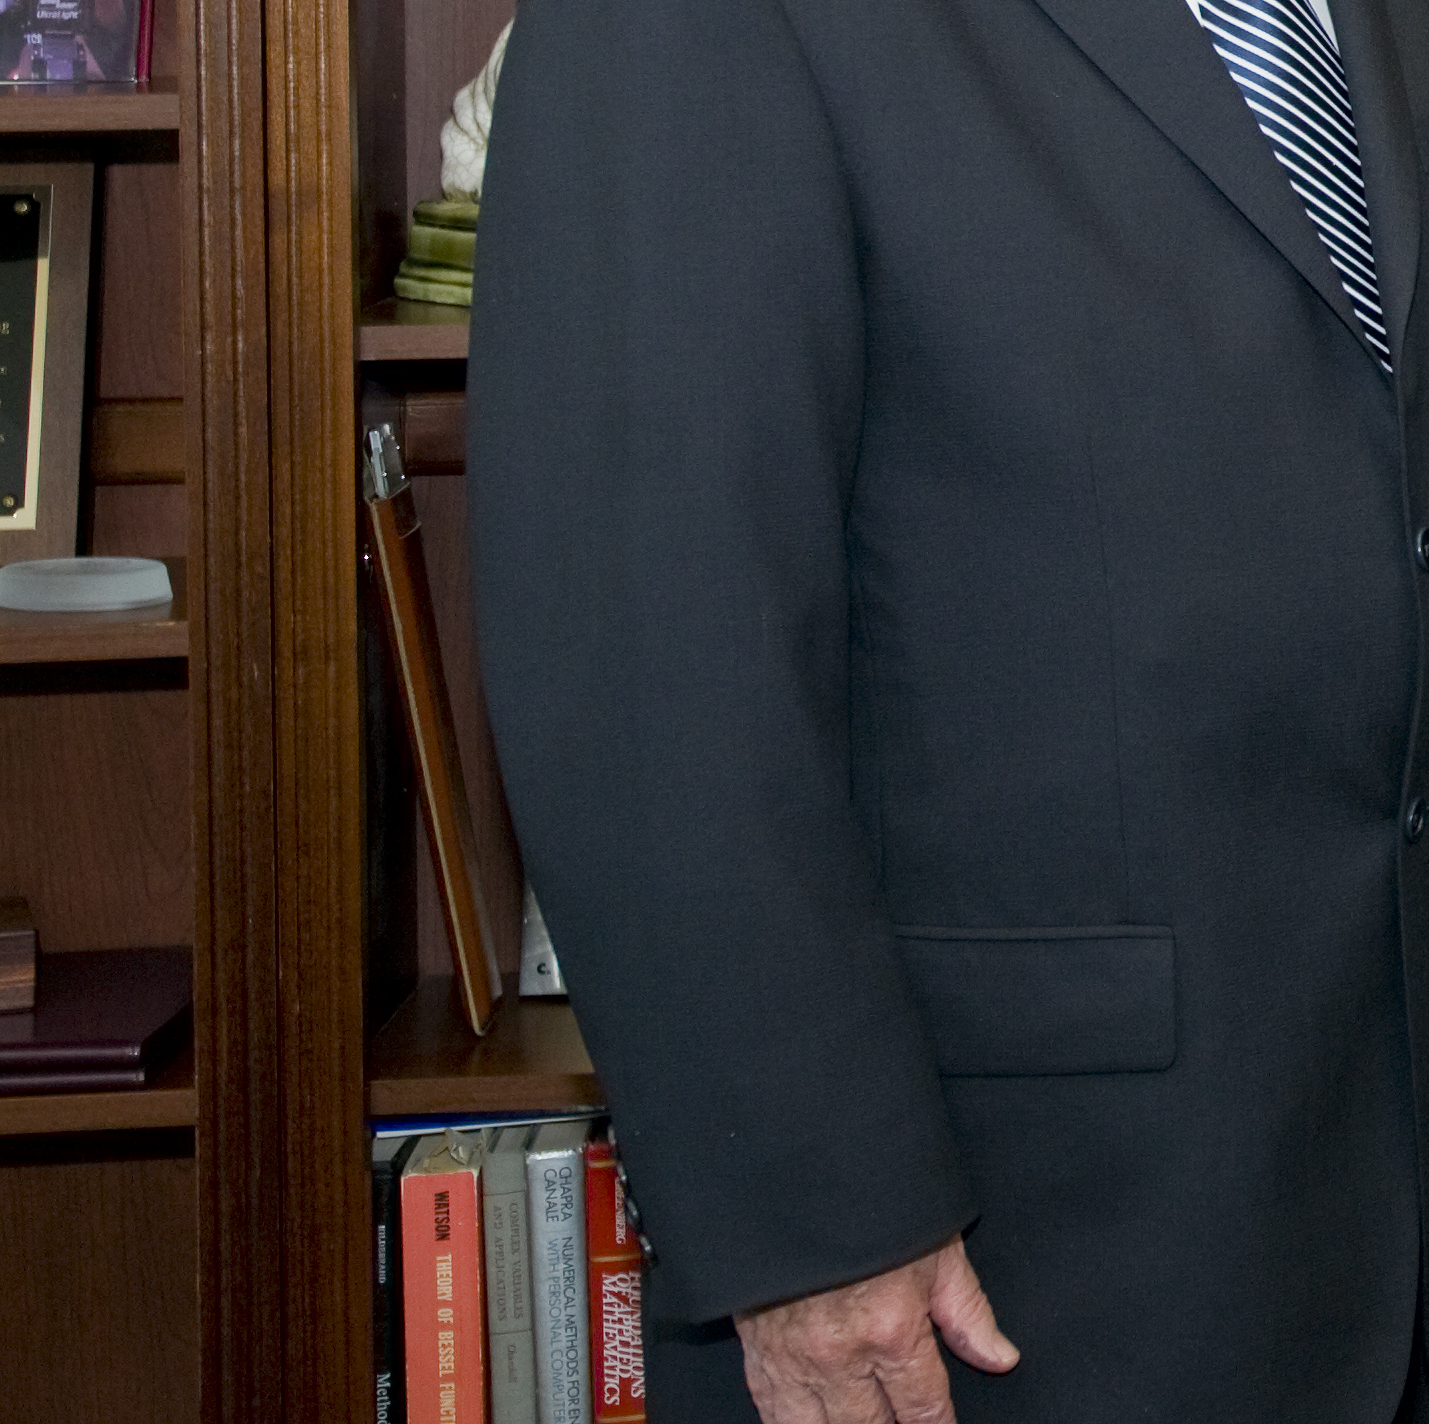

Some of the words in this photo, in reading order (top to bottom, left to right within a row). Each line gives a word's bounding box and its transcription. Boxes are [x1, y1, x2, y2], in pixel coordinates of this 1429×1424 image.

[434, 1190, 451, 1242] WATSON
[544, 1168, 560, 1223] CANALE
[559, 1166, 574, 1222] CHAPRA
[509, 1202, 521, 1255] COMPLEX
[512, 1260, 524, 1320] VARIABLES
[562, 1236, 577, 1311] NUMERICAL
[616, 1273, 631, 1298] OF
[565, 1313, 580, 1377] METHODS
[602, 1273, 620, 1406] MATHEMATICS
[617, 1301, 632, 1379] APPLIED
[629, 1270, 646, 1399] FOUNDATIONS
[567, 1380, 581, 1400] FOR
